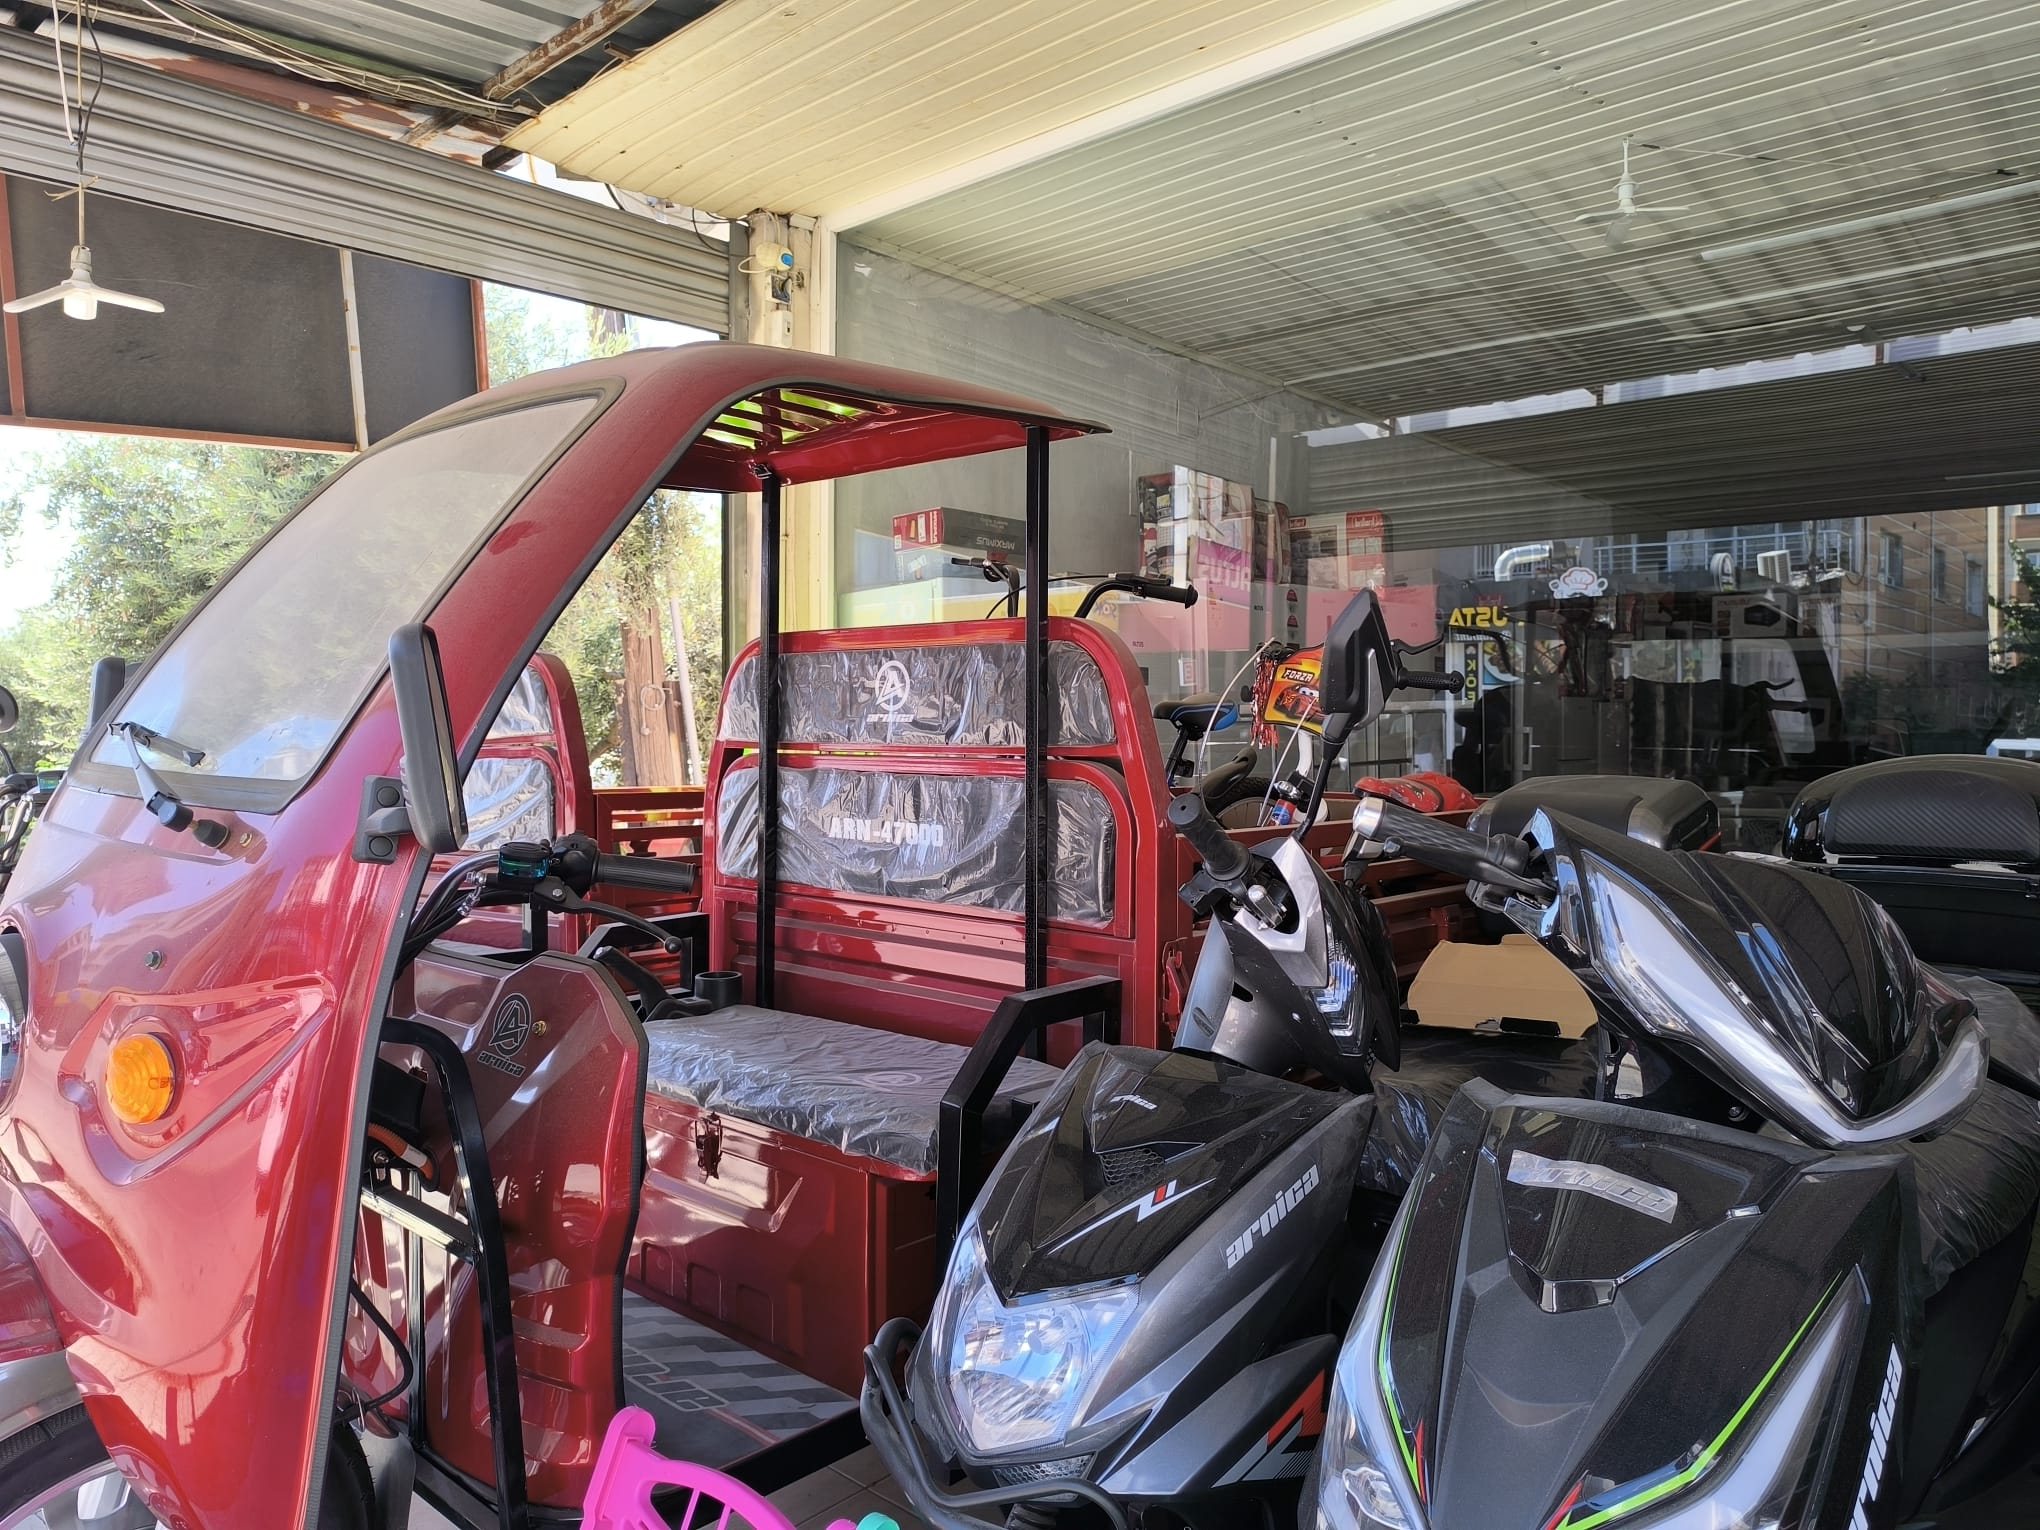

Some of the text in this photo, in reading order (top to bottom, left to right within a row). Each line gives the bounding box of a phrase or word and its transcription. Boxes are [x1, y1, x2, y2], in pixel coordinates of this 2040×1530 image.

[976, 536, 1016, 550] MAXIMUS
[1283, 669, 1314, 682] FORZA
[478, 1051, 526, 1078] arnica
[1226, 1164, 1320, 1269] arnica
[1849, 1342, 1902, 1530] rnica
